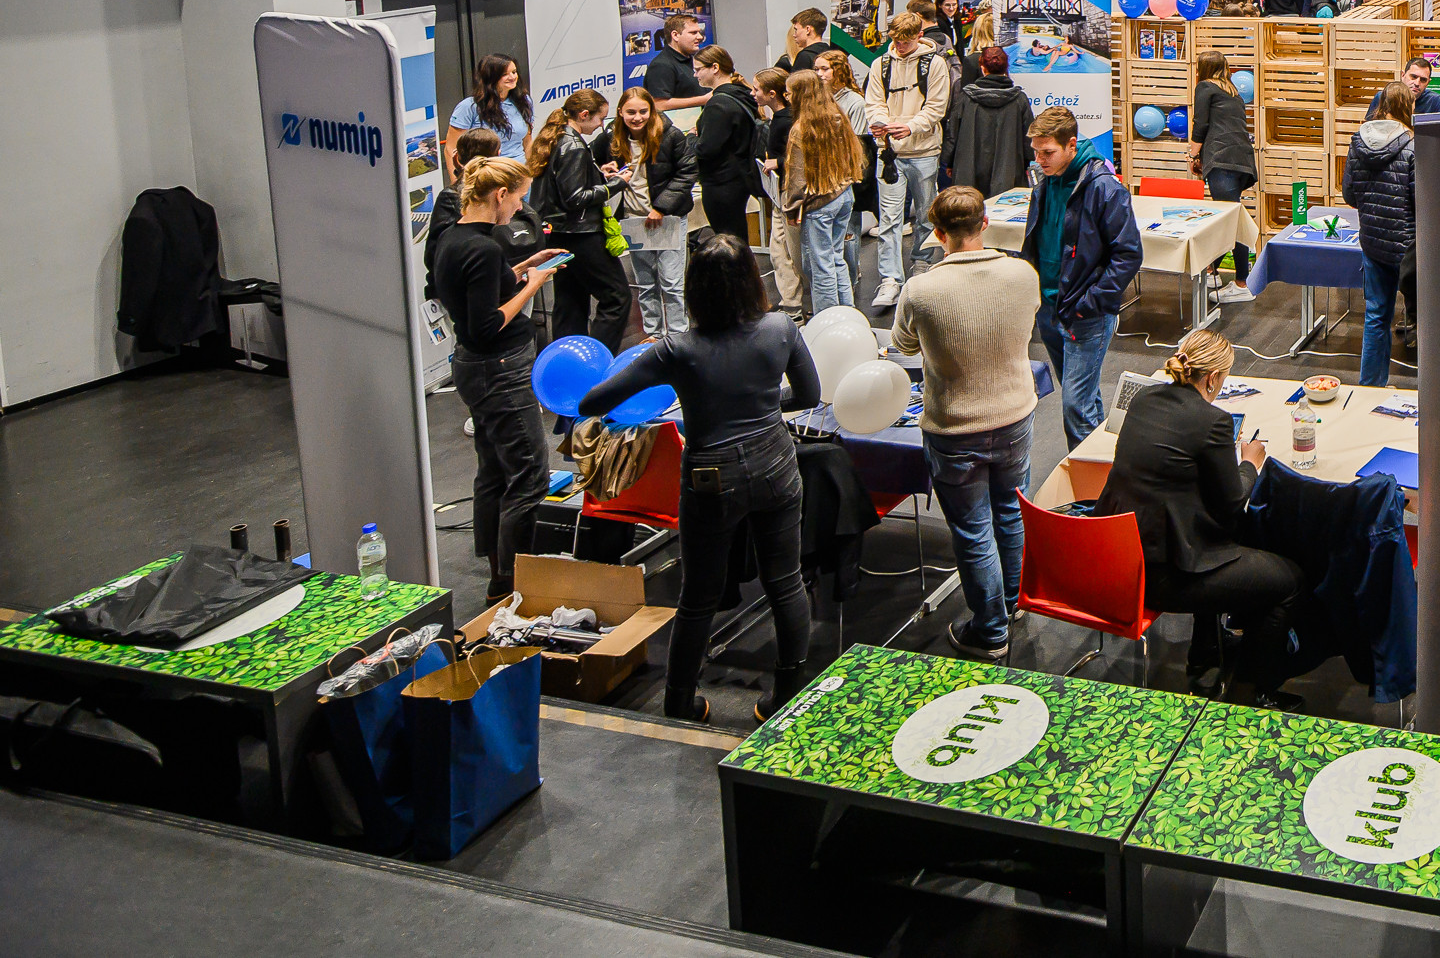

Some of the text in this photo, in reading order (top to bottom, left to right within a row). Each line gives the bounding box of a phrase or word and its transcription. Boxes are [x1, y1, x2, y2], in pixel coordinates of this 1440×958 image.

[557, 73, 616, 98] metalna
[1045, 92, 1080, 106] Čatež
[308, 111, 383, 168] numip
[926, 693, 1021, 768] klub
[1345, 762, 1416, 850] klub
